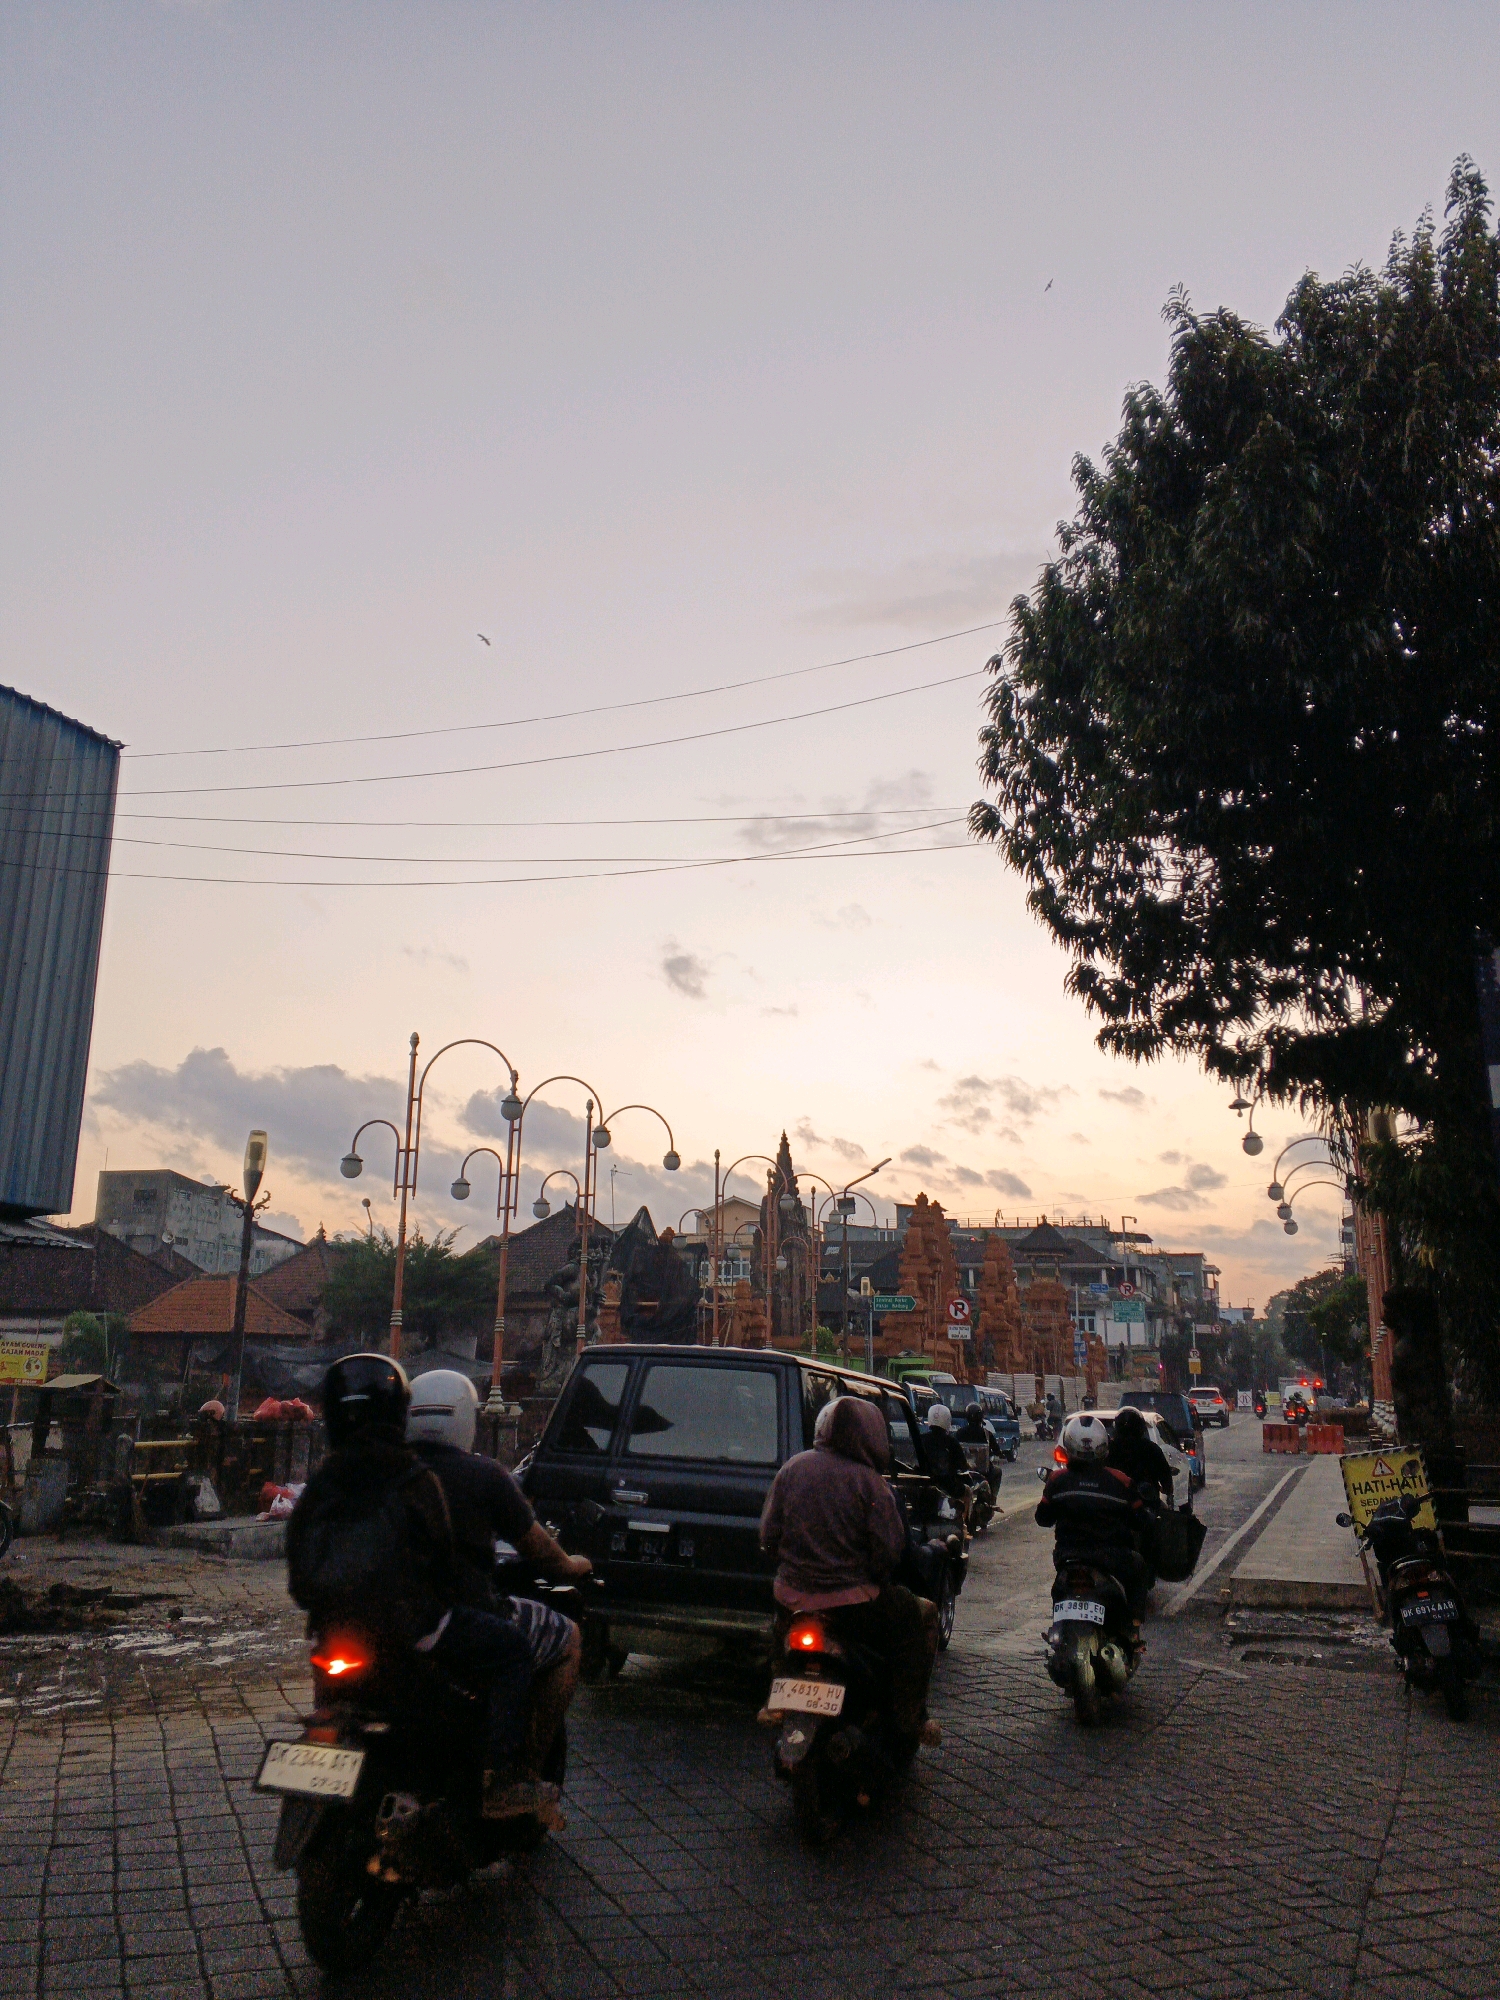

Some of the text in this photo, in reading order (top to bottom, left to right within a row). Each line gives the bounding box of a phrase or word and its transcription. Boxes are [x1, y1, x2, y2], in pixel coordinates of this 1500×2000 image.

[21, 1342, 47, 1350] GORENG
[1352, 1475, 1424, 1496] HATI-HATI
[1054, 1604, 1064, 1613] DK
[1094, 1604, 1105, 1615] EU
[1402, 1608, 1414, 1618] DK
[771, 1681, 787, 1694] DK
[826, 1687, 842, 1699] HV
